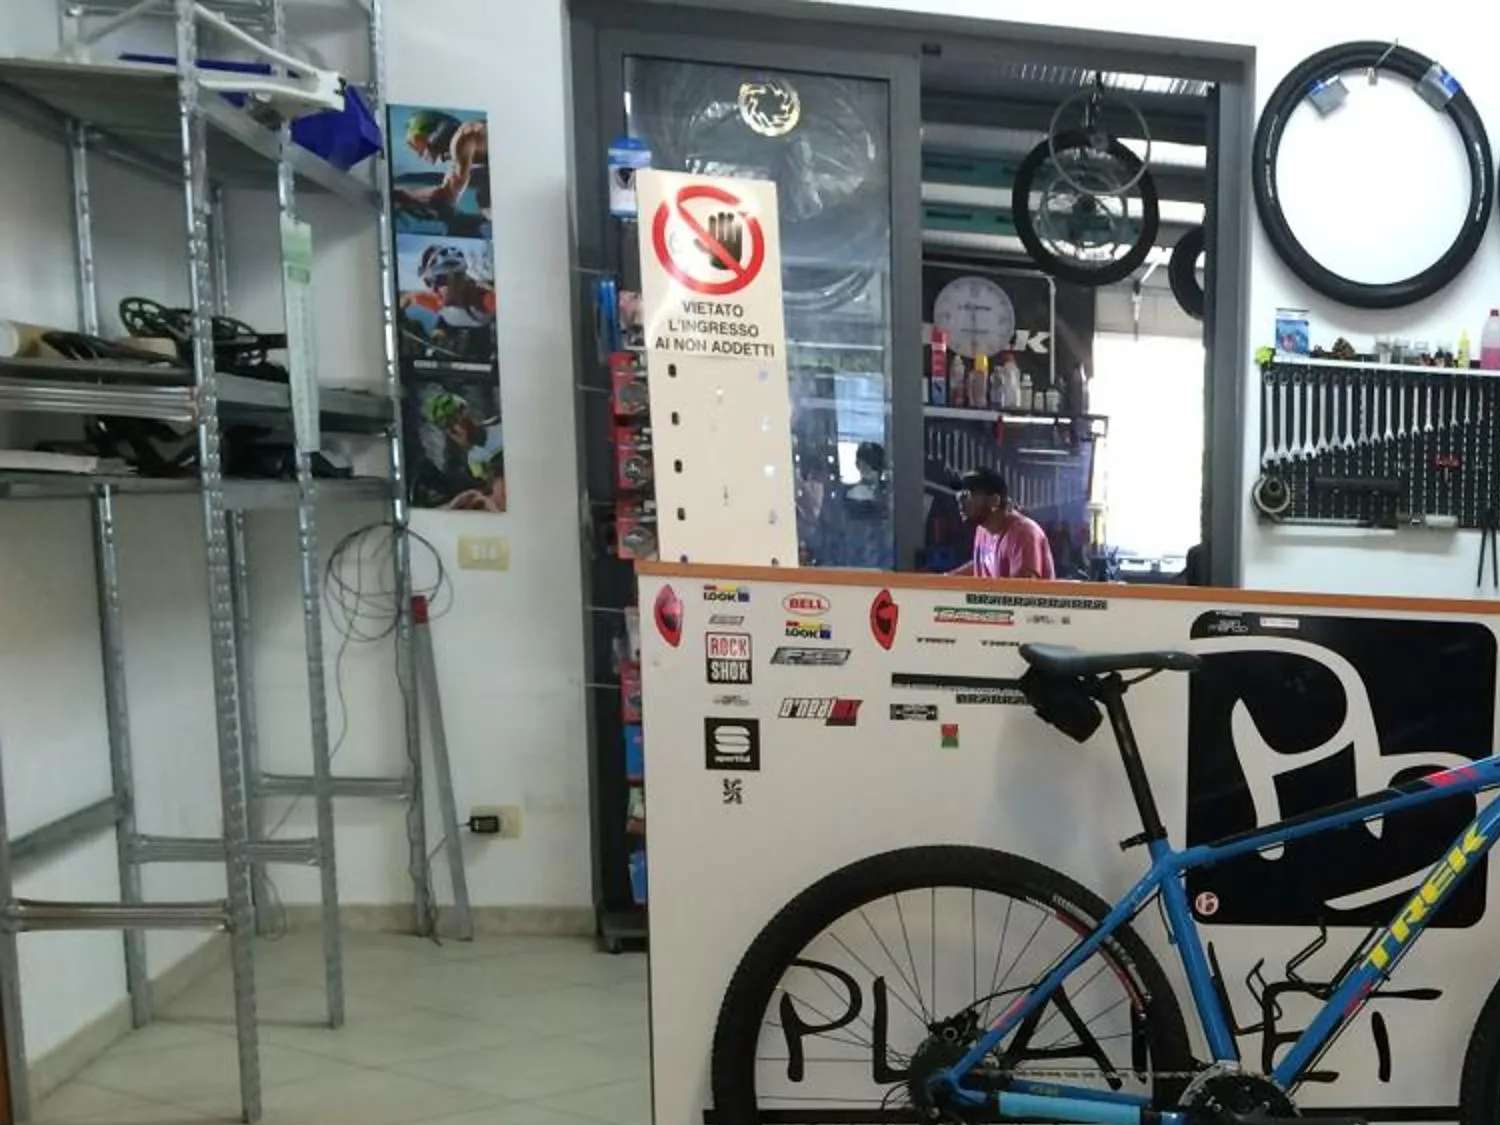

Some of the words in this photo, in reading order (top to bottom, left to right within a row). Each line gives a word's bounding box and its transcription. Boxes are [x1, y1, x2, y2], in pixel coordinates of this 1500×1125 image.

[683, 301, 744, 317] VIETATO
[668, 319, 759, 338] L'INGRESSO
[655, 336, 670, 350] AI
[674, 338, 707, 352] NON
[712, 340, 775, 358] ADDETTI
[703, 591, 737, 602] LOOK
[789, 597, 824, 610] BELL
[785, 627, 818, 639] LOOK
[710, 637, 748, 657] ROCK
[711, 660, 749, 681] SHOX
[1360, 822, 1489, 971] TREK
